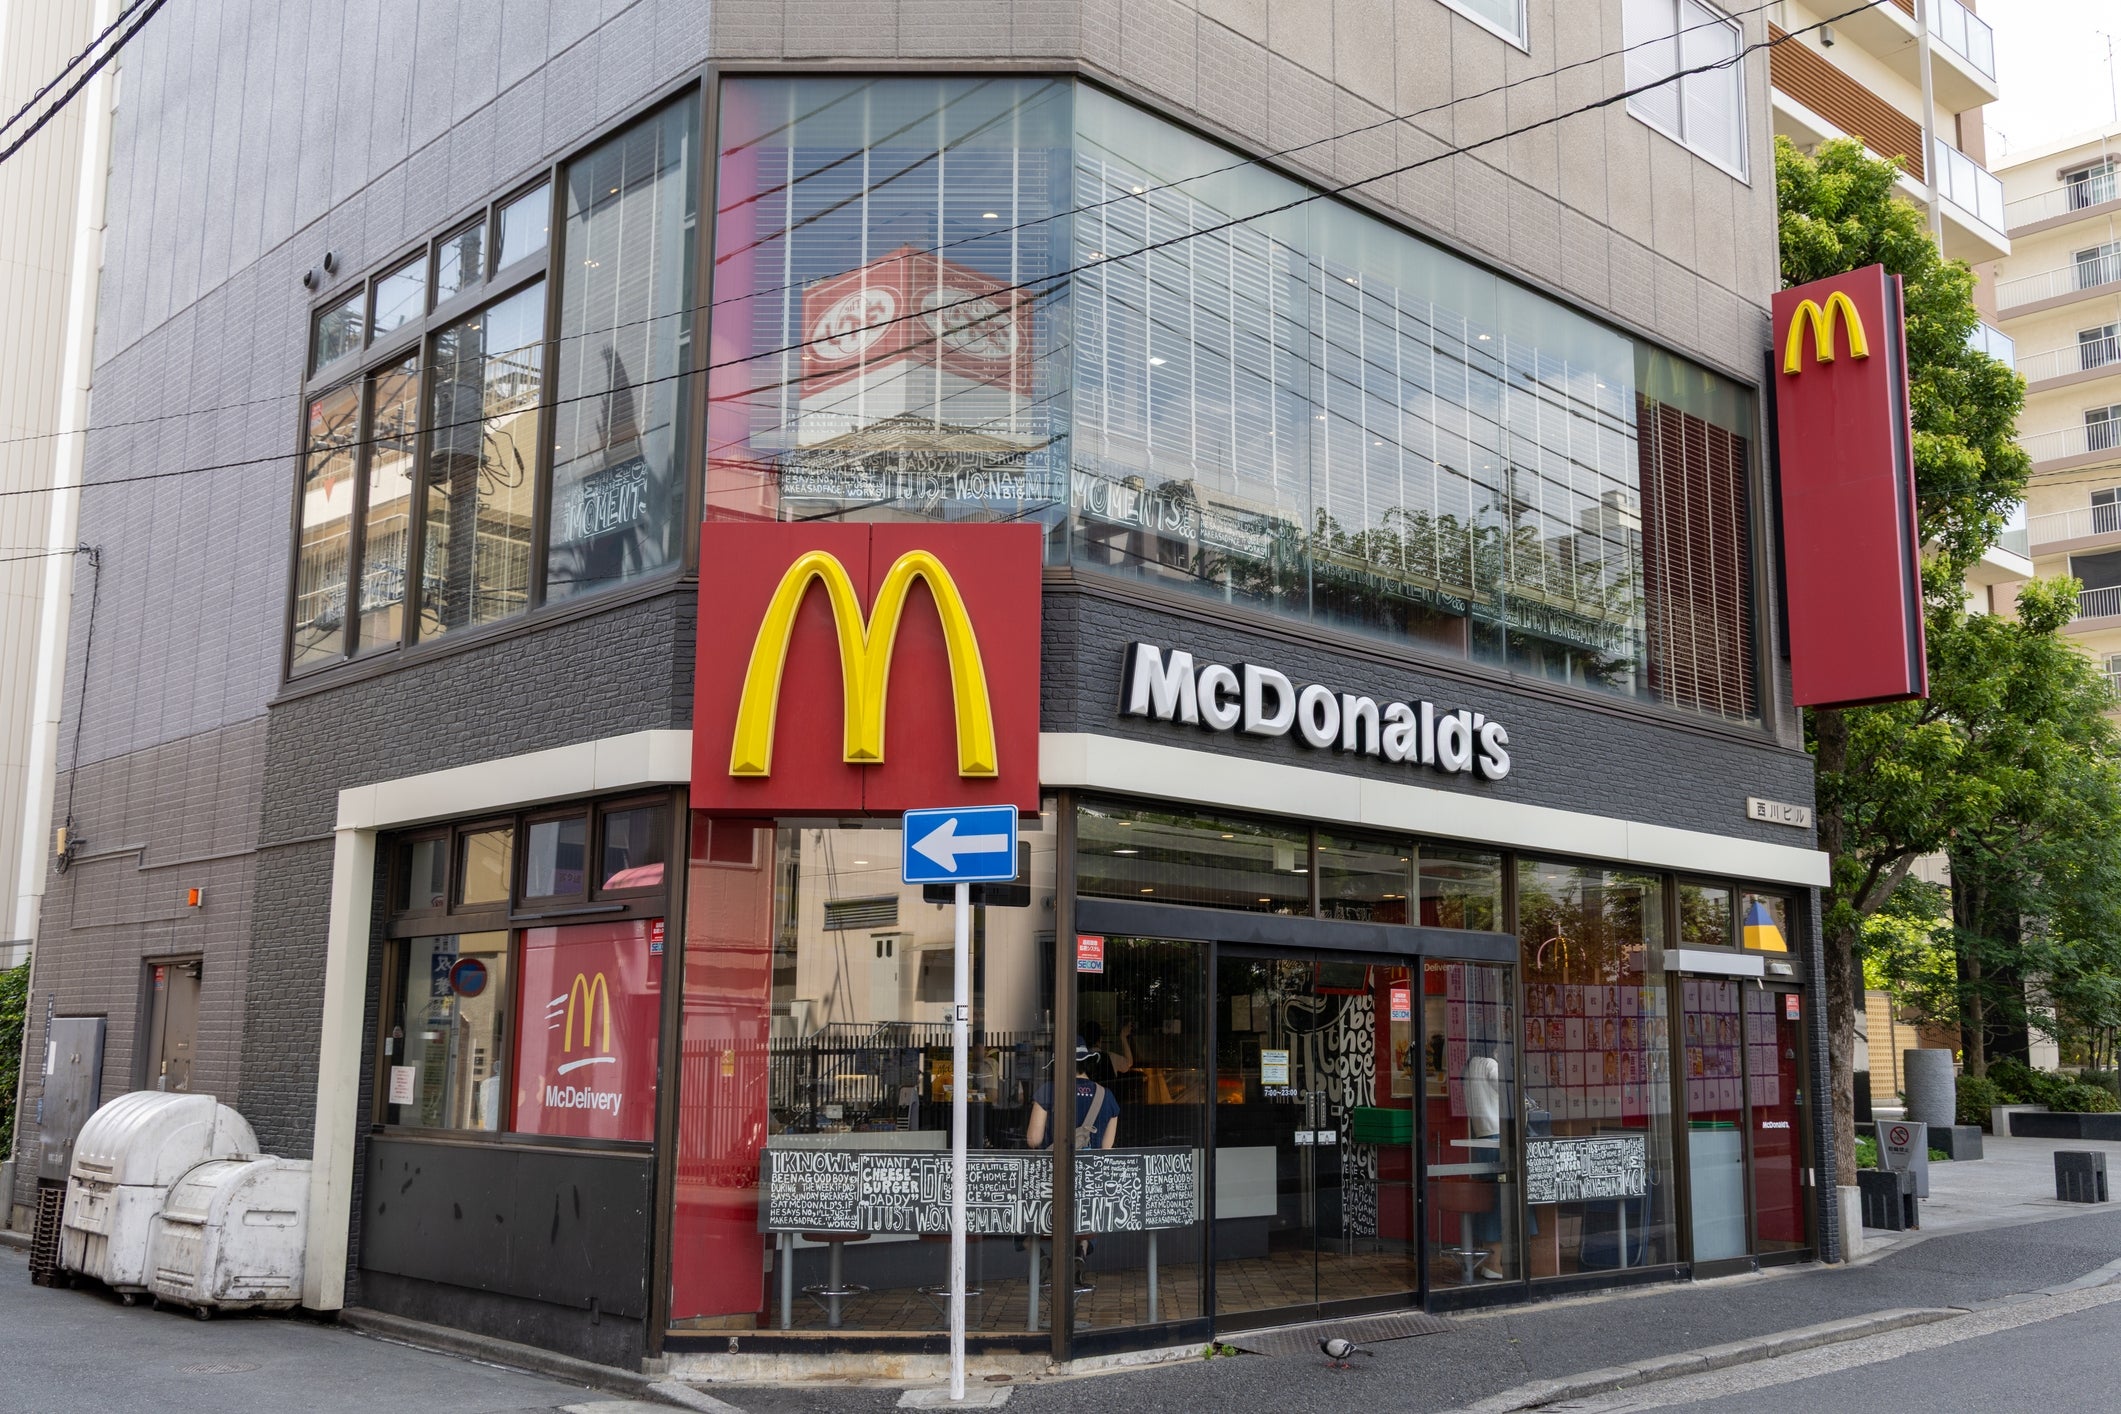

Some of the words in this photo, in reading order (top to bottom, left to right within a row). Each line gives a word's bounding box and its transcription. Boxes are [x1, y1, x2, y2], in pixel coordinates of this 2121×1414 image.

[1071, 470, 1188, 532] MOMENTS
[1126, 641, 1511, 782] McDonald’s
[1078, 960, 1102, 970] SECOM
[545, 1085, 623, 1117] McDelivery
[874, 1157, 911, 1168] WANT
[862, 1180, 920, 1195] BURGER
[968, 1171, 983, 1183] OF
[982, 1172, 1007, 1182] HOME
[1084, 1163, 1095, 1197] HAPPY
[873, 1205, 914, 1231] JUST
